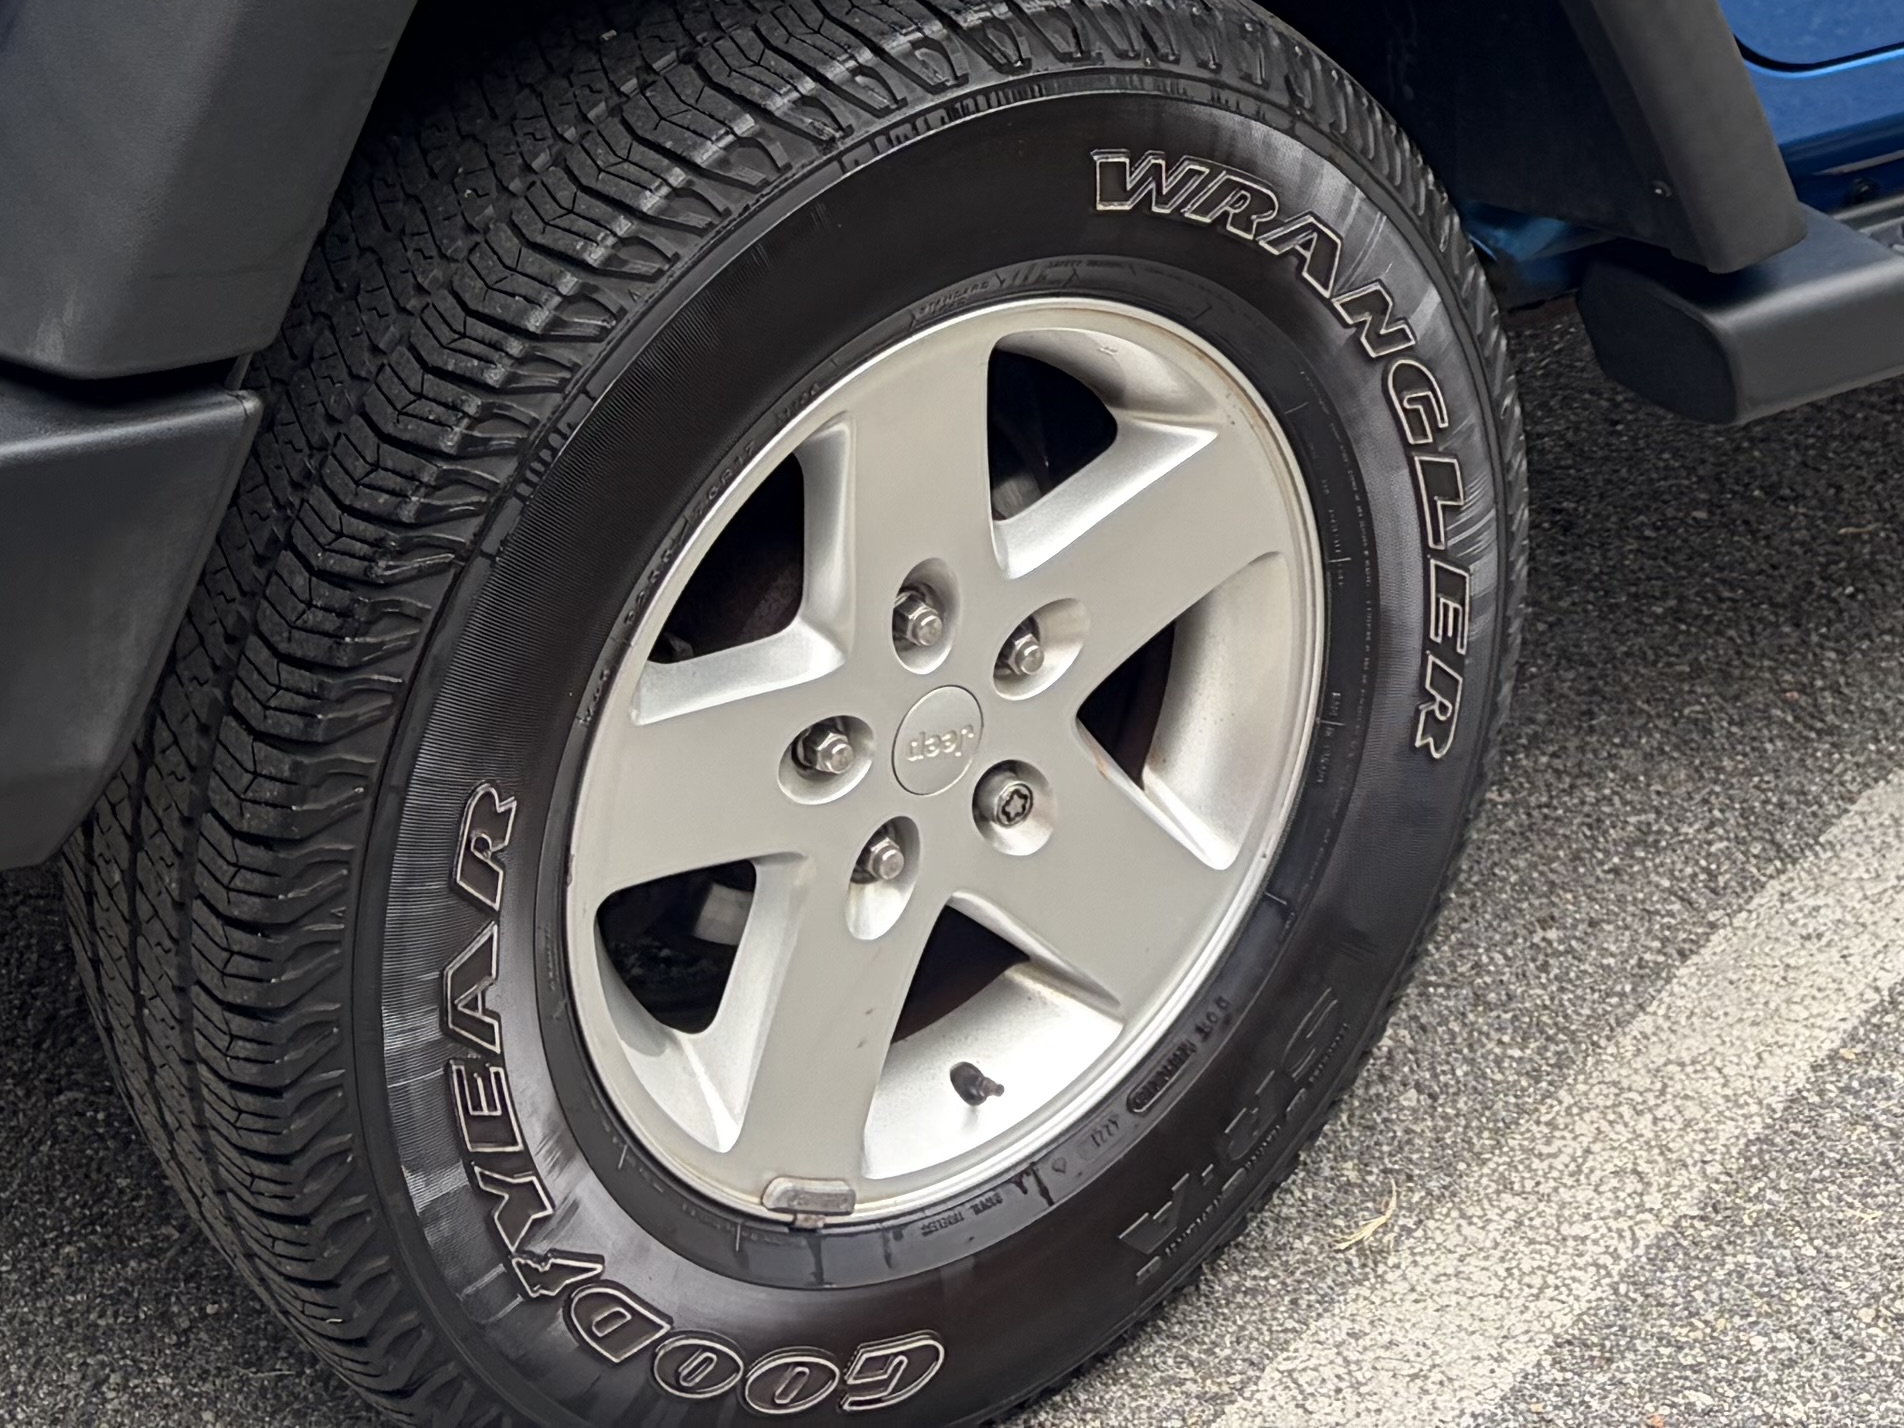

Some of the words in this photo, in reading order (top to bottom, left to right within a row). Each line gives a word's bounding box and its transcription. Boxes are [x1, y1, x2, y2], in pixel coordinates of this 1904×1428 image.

[907, 724, 974, 761] Jeep
[1091, 148, 1474, 759] WRANGLER
[441, 782, 946, 1413] GOODYEAR
